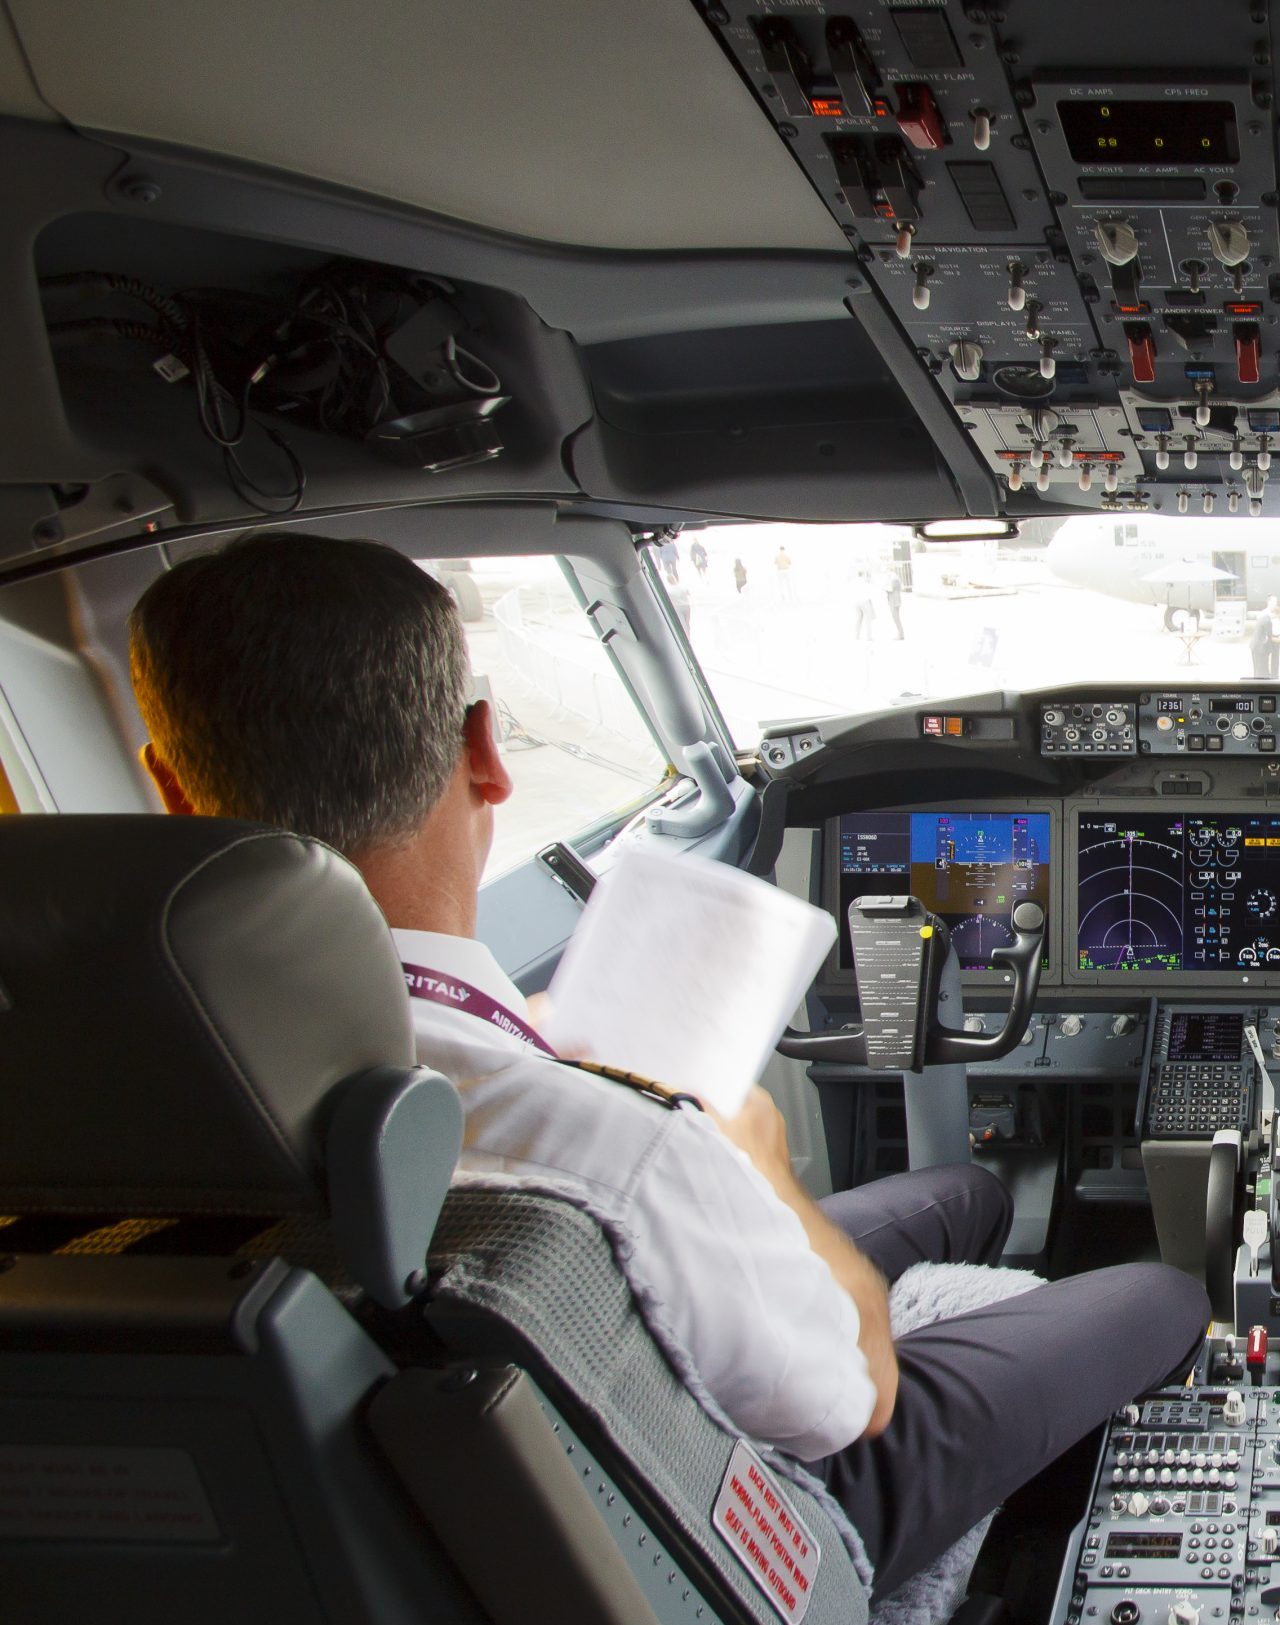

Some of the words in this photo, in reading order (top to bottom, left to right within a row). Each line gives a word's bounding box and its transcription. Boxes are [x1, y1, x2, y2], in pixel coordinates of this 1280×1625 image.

[943, 74, 975, 82] FLAPS
[1101, 107, 1110, 117] 0
[1155, 138, 1164, 147] 0
[1202, 138, 1210, 147] 0
[1236, 702, 1249, 710] 100
[1253, 1331, 1261, 1352] 1
[749, 1464, 765, 1493] BACK
[764, 1488, 780, 1513] REST
[778, 1509, 794, 1536] MUST
[792, 1530, 802, 1549] BE
[800, 1542, 808, 1558] IN
[730, 1474, 754, 1516] NORMAL
[752, 1506, 774, 1539] FLIGHT
[770, 1532, 794, 1575] POSITION
[792, 1562, 809, 1592] WHEN
[725, 1507, 742, 1534] SEAT
[740, 1527, 749, 1544] IS
[747, 1538, 769, 1574] MOVING
[768, 1567, 796, 1611] OUTBOARD
